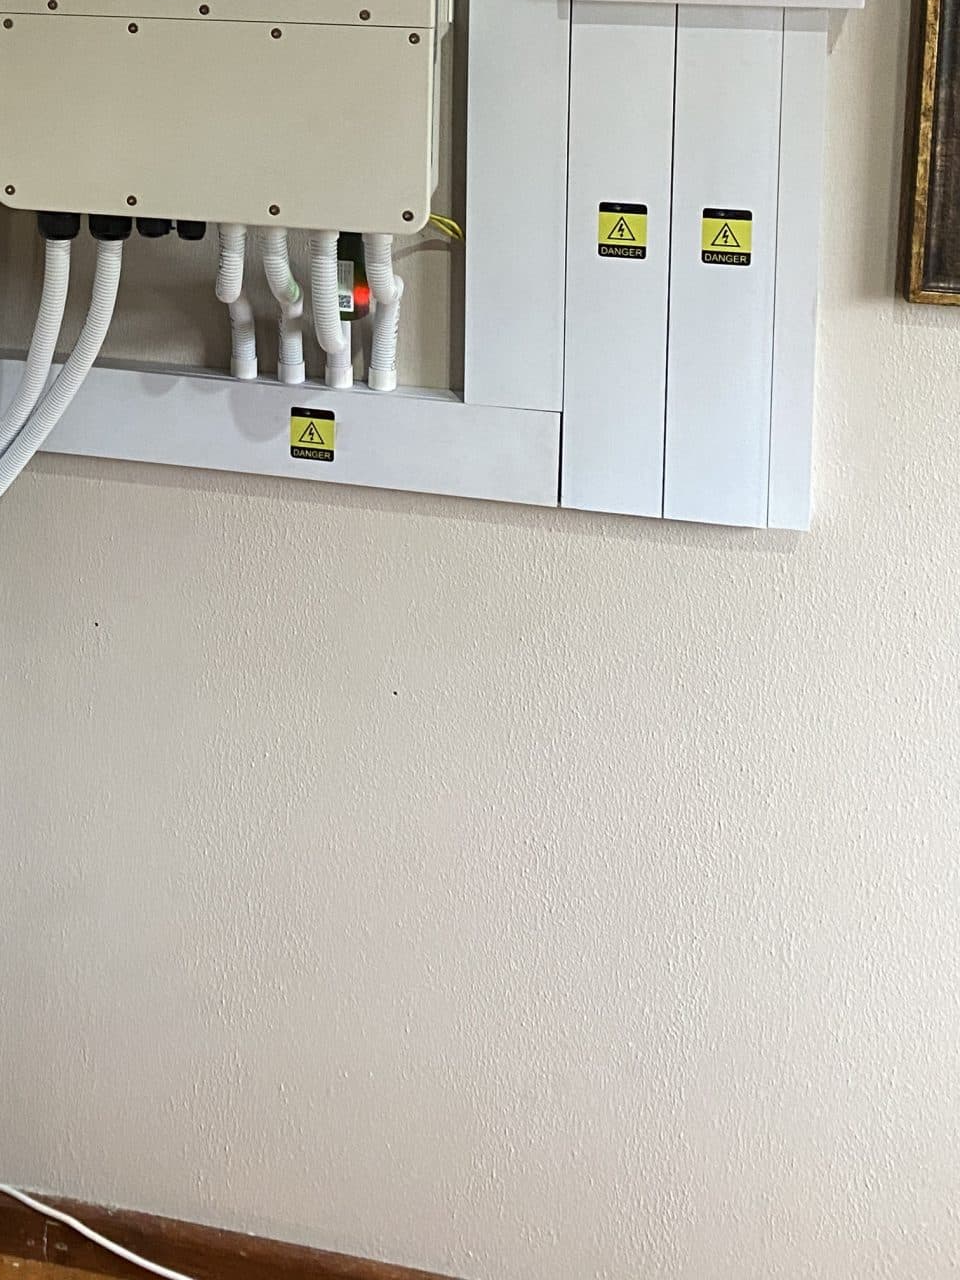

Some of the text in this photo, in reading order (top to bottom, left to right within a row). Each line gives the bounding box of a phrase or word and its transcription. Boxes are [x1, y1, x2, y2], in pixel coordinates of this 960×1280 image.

[600, 246, 643, 257] DANGER
[704, 253, 747, 264] DANGER
[293, 448, 331, 460] DANGER
